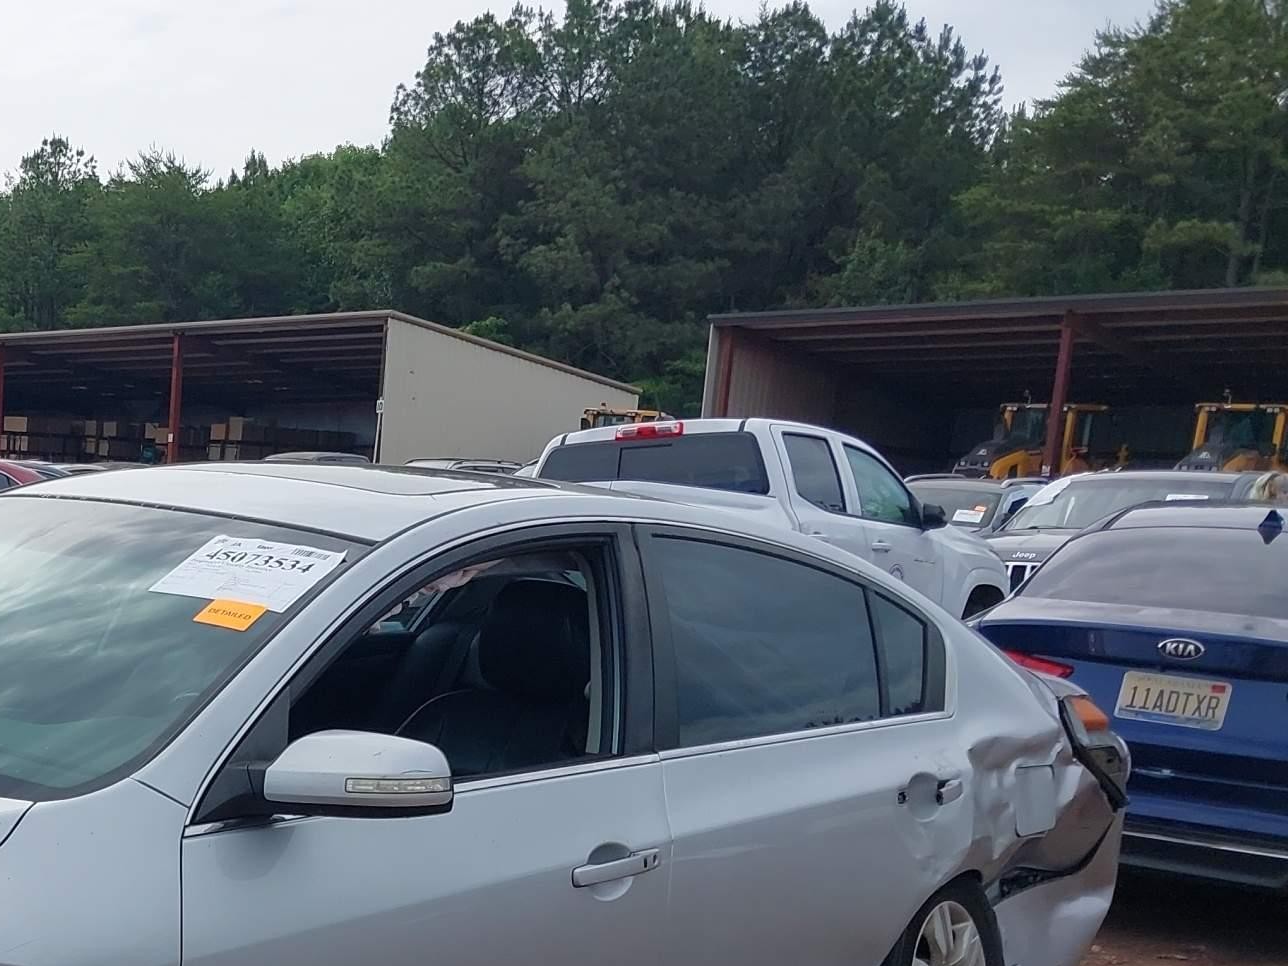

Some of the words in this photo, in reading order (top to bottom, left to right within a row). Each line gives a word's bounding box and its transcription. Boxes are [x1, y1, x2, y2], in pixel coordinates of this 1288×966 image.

[205, 547, 314, 573] 45073534
[1011, 551, 1036, 560] Jeep
[208, 607, 252, 621] DETAILED
[1165, 642, 1196, 657] KIA
